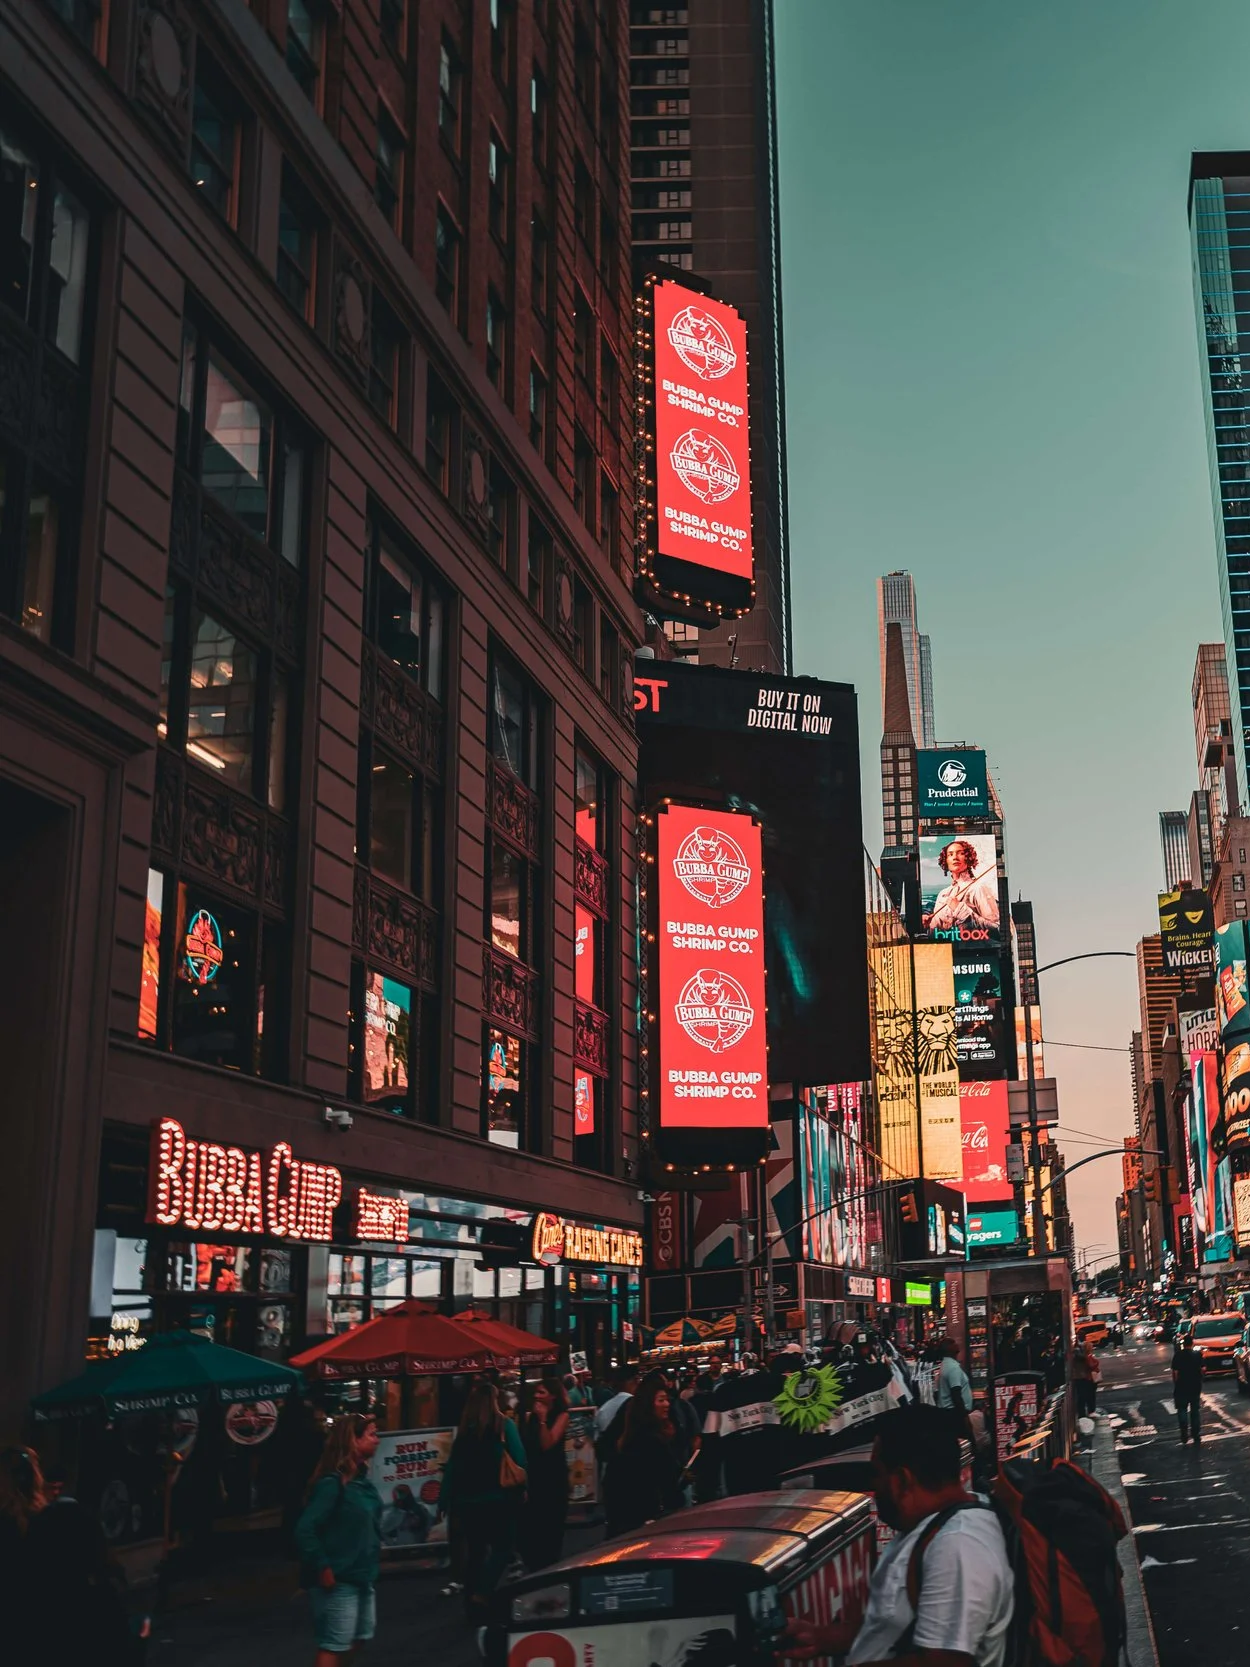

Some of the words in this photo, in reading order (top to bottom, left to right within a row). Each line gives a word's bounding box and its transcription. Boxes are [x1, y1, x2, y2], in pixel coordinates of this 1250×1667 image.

[671, 331, 705, 352] BUBBA
[707, 342, 736, 363] GUMP
[662, 379, 706, 404] BUBBA
[708, 397, 744, 416] GUMP
[667, 394, 715, 418] SHRIMP
[717, 412, 739, 428] CO.
[674, 455, 708, 474] BUBBA
[709, 465, 738, 486] GUMP
[664, 506, 708, 529] BUBBA
[711, 521, 747, 540] GUMP
[670, 521, 718, 543] SHRIMP
[721, 537, 743, 552] CO.
[757, 688, 785, 709] BUY
[785, 692, 801, 711] IT
[803, 694, 821, 714] ON
[747, 708, 798, 732] DIGITAL
[801, 715, 833, 735] NOW
[927, 787, 979, 798] Prudential
[678, 861, 715, 876] BUBBA
[717, 862, 749, 879] GUMP
[666, 921, 716, 937] BUBBA
[718, 925, 759, 940] GUMP
[934, 927, 990, 941] britbox
[672, 936, 727, 951] SHRIMP
[728, 941, 753, 954] CO.
[679, 1007, 717, 1021] BUBBA
[719, 1006, 751, 1022] GUMP
[971, 1013, 993, 1021] Home
[1186, 1010, 1216, 1032] LITTLE
[669, 1070, 718, 1083] BUBBA
[720, 1071, 762, 1084] GUMP
[674, 1085, 730, 1098] SHRIMP
[731, 1086, 757, 1099] CO.
[929, 1088, 958, 1097] MUSICAL
[156, 1117, 264, 1234] BUBBA
[267, 1141, 342, 1240] GUMP
[658, 1205, 673, 1244] CBS
[564, 1224, 609, 1262] RAISING
[610, 1232, 643, 1266] CANE'S
[396, 1441, 428, 1454] RUN
[384, 1450, 439, 1466] FORREST
[396, 1460, 428, 1474] RUN
